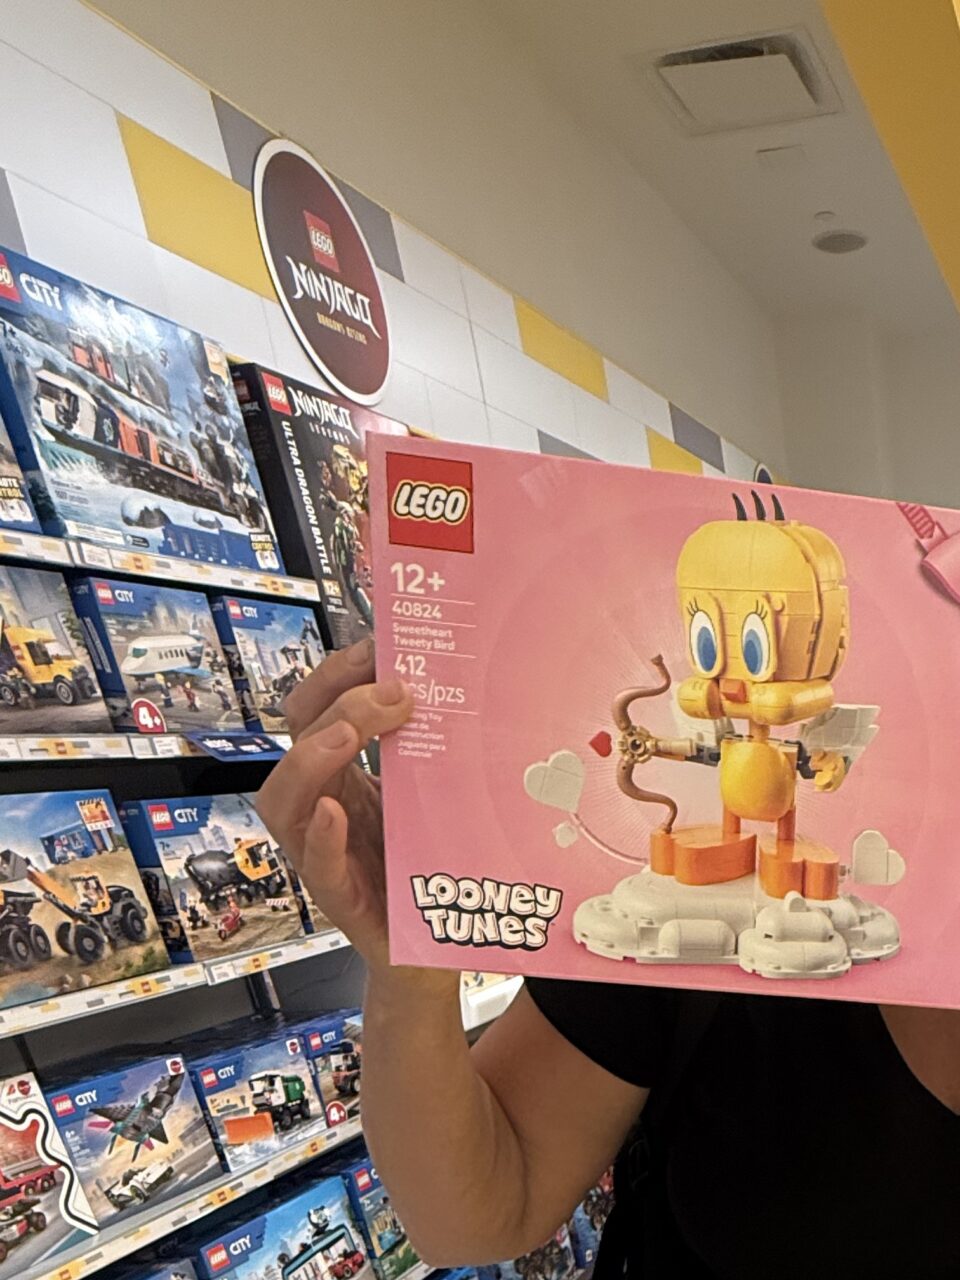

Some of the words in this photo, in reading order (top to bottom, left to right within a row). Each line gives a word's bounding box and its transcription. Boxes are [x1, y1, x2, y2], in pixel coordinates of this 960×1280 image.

[310, 226, 335, 258] LEGO
[20, 272, 62, 311] CITY
[285, 255, 381, 340] NINJAGO
[267, 385, 287, 405] LEGO
[288, 386, 360, 440] NINJAGO
[281, 421, 300, 465] ULTRA
[294, 466, 319, 525] DRAGON
[311, 526, 332, 575] BATTLE
[393, 480, 469, 525] LEGO
[390, 561, 446, 595] 12+
[114, 589, 135, 604] CITY
[242, 606, 258, 618] CITY
[391, 600, 443, 619] 40824
[392, 622, 453, 638] Sweetheart
[392, 634, 433, 650] Tweety
[434, 640, 456, 651] Bird
[394, 653, 427, 676] 412
[407, 679, 465, 706] cs/pzs
[138, 706, 162, 729] 4+
[174, 808, 198, 823] CITY
[322, 1031, 337, 1043] CITY
[217, 1065, 235, 1080] CITY
[75, 1089, 98, 1106] CITY
[229, 1234, 252, 1256] CITY
